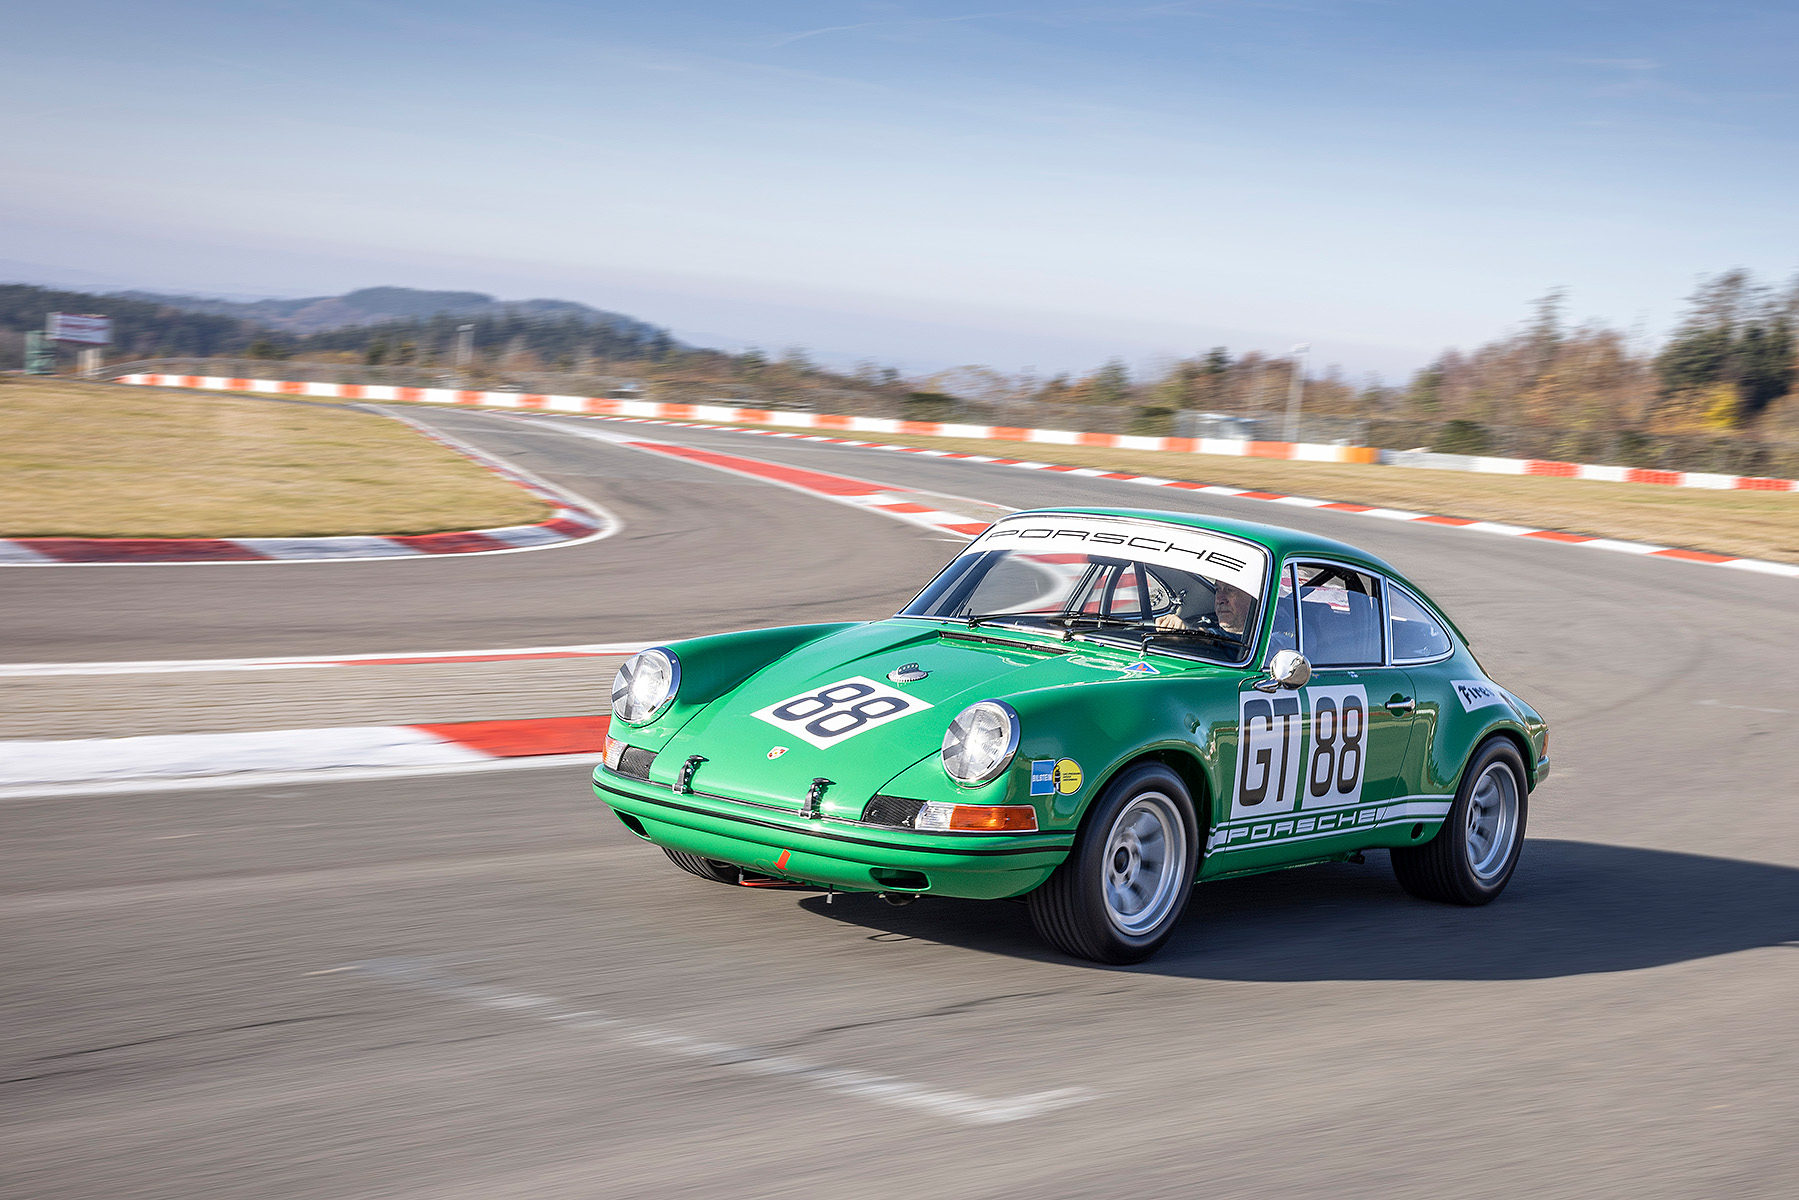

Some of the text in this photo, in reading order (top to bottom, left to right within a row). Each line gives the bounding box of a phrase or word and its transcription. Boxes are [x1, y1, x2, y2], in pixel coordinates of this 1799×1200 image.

[984, 529, 1247, 572] PORSCHE
[773, 683, 910, 738] 88
[1239, 695, 1363, 807] GT 88
[1227, 808, 1377, 844] PORSCHE
